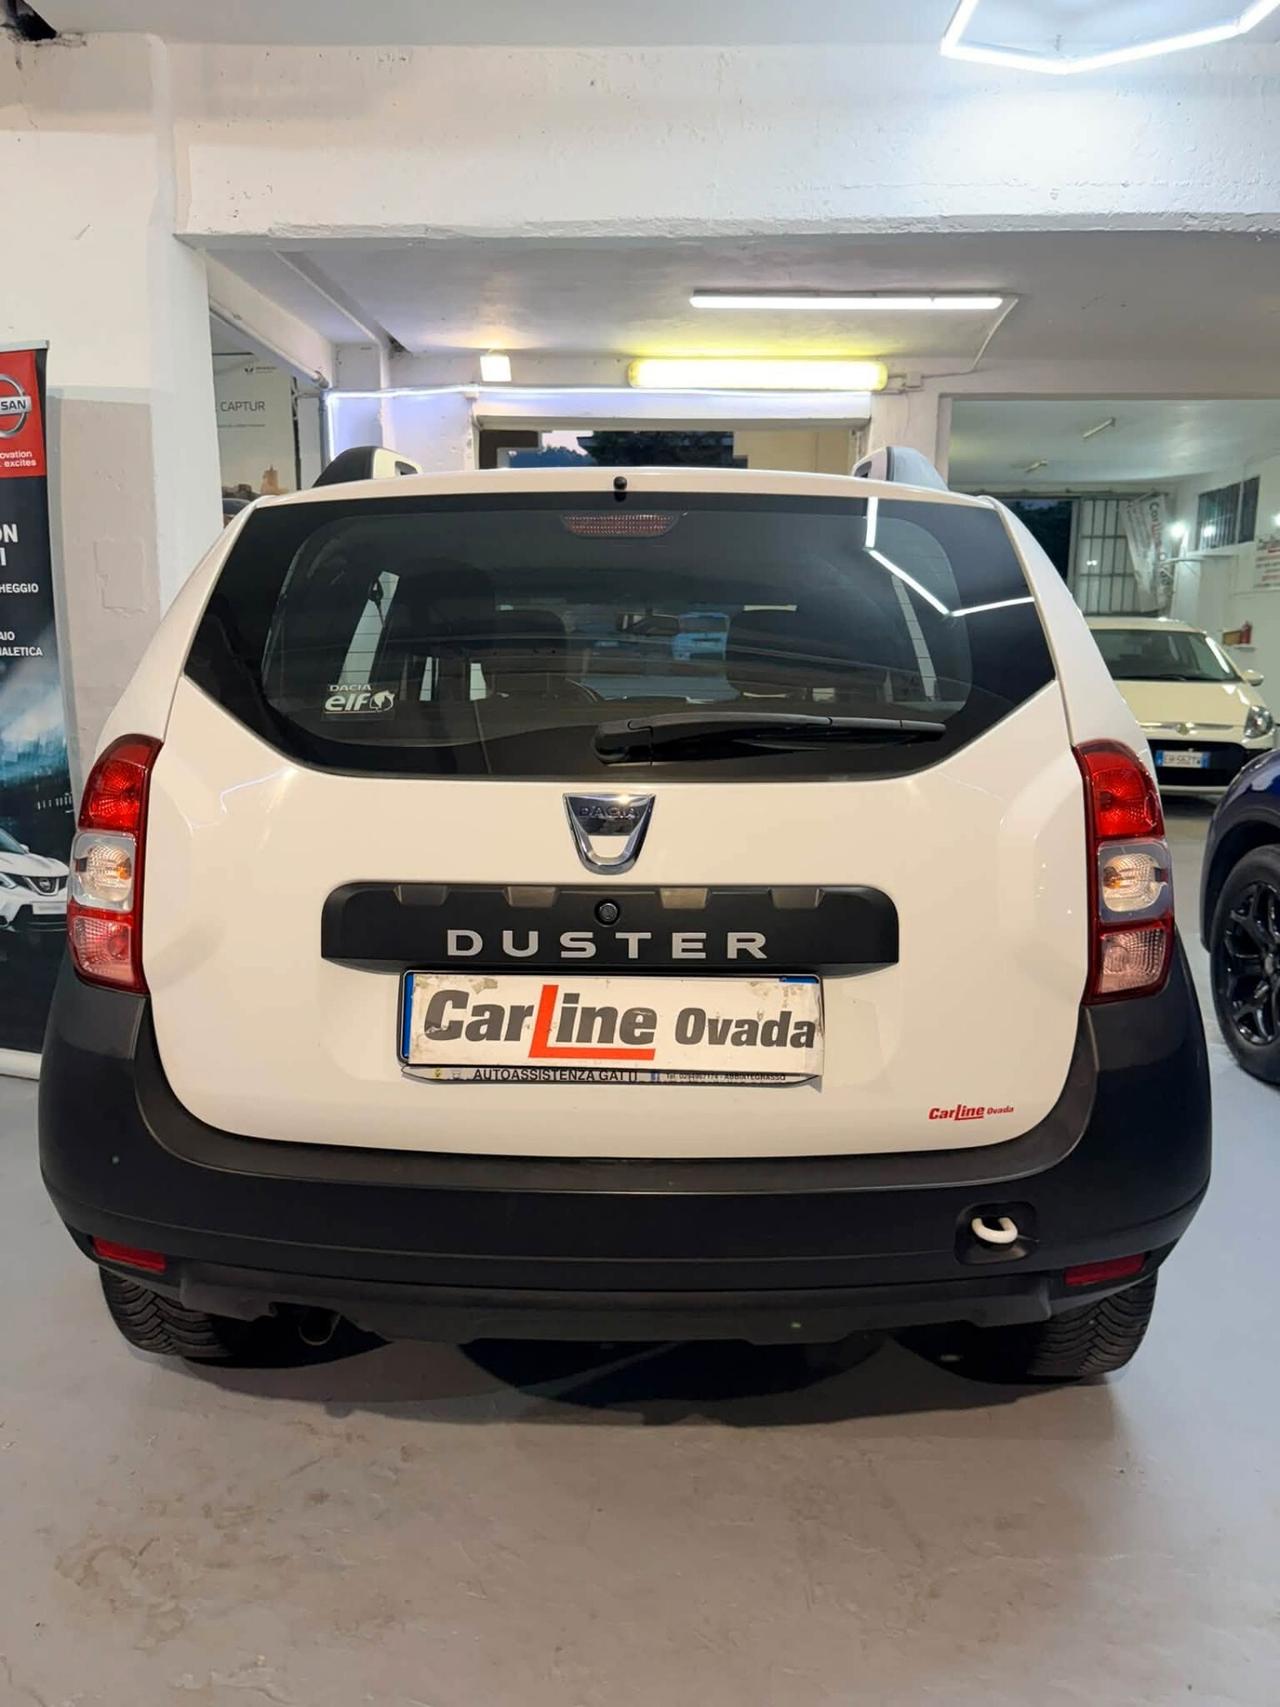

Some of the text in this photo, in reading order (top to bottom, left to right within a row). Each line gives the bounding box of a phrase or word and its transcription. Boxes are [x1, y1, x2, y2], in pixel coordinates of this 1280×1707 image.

[220, 400, 266, 412] CAPTUR
[330, 683, 372, 692] DACIA
[325, 692, 371, 711] elf
[579, 804, 637, 819] DACIA
[447, 929, 768, 960] DUSTER
[424, 984, 816, 1061] CarLine Ovada
[473, 1069, 595, 1081] AUTOASSISTENZA
[928, 1104, 1014, 1121] CarLine Ovada
